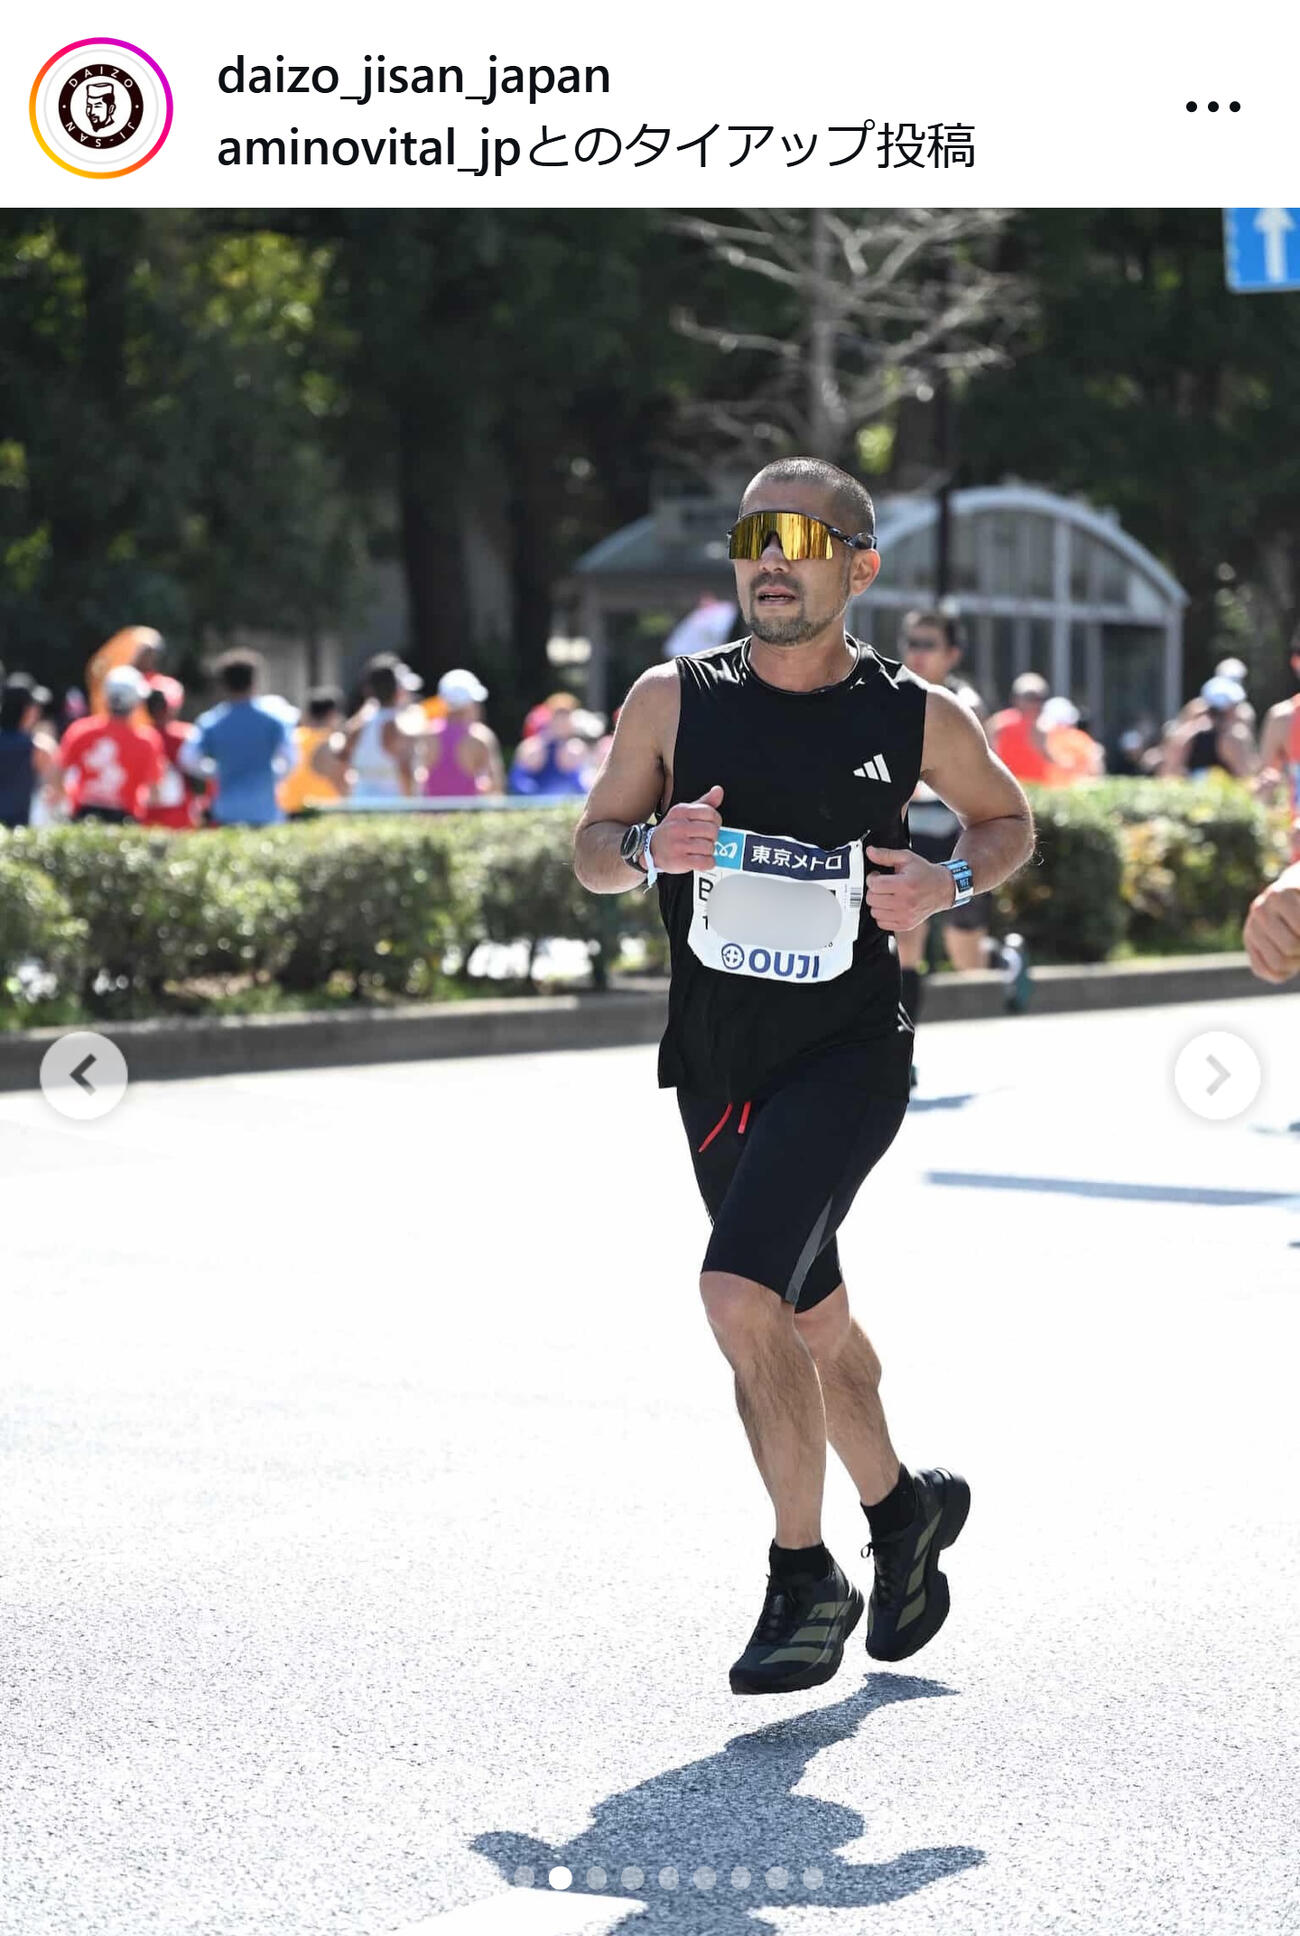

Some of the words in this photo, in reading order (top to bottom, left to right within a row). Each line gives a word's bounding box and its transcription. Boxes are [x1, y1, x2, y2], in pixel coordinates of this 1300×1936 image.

[750, 845, 842, 872] 東京メトロ
[748, 948, 820, 979] OUJI
